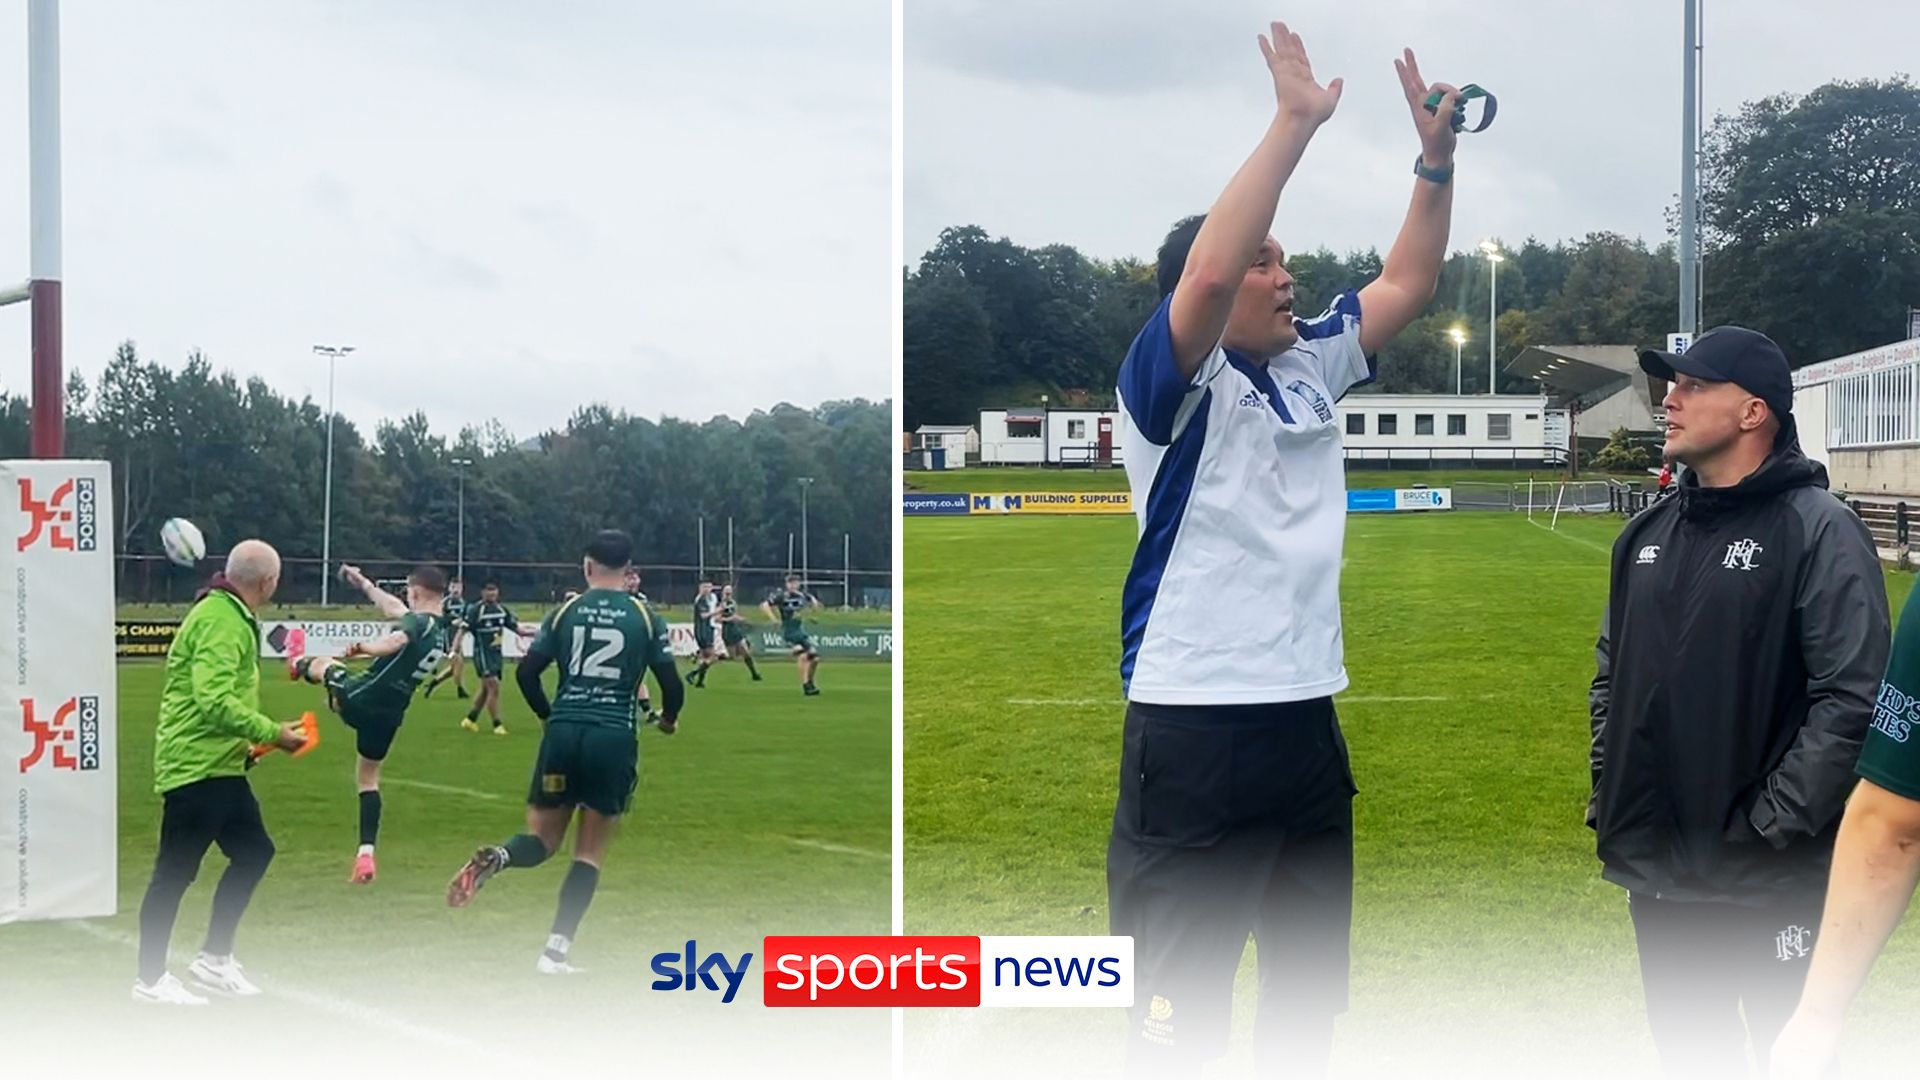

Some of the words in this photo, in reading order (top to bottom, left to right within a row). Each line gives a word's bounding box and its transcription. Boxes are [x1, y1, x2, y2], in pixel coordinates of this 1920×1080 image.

[974, 495, 1021, 512] MKM
[1025, 495, 1076, 504] BUILDING
[1080, 495, 1128, 504] SUPPLIES
[1403, 491, 1431, 500] BRUCE
[80, 479, 94, 549] FOSROC
[567, 625, 625, 680] 12
[821, 633, 869, 647] numbers
[1877, 680, 1920, 725] RD'S
[82, 698, 96, 768] FOSROC
